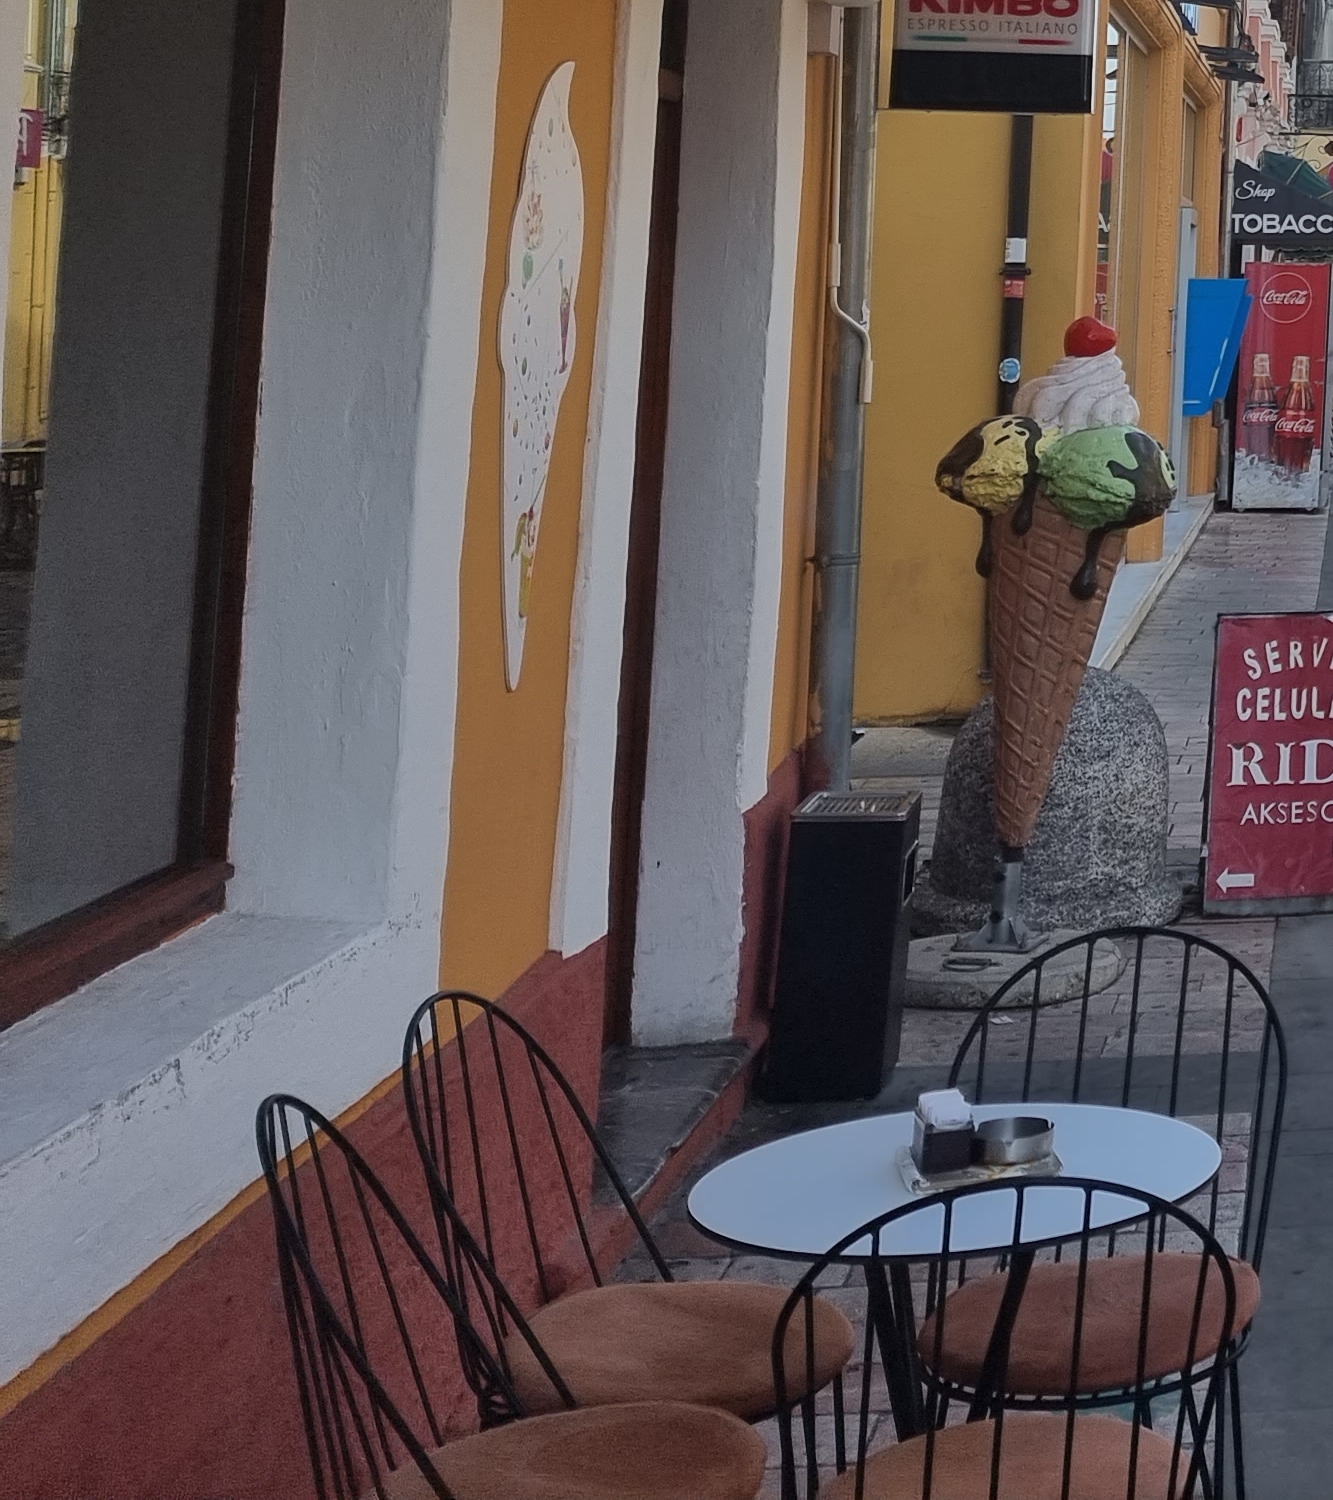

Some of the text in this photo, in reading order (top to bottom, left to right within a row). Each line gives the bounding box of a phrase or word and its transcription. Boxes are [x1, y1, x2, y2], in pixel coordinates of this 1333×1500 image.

[907, 18, 1079, 36] ESPRESSO ITALIANO
[1234, 179, 1276, 202] Shop
